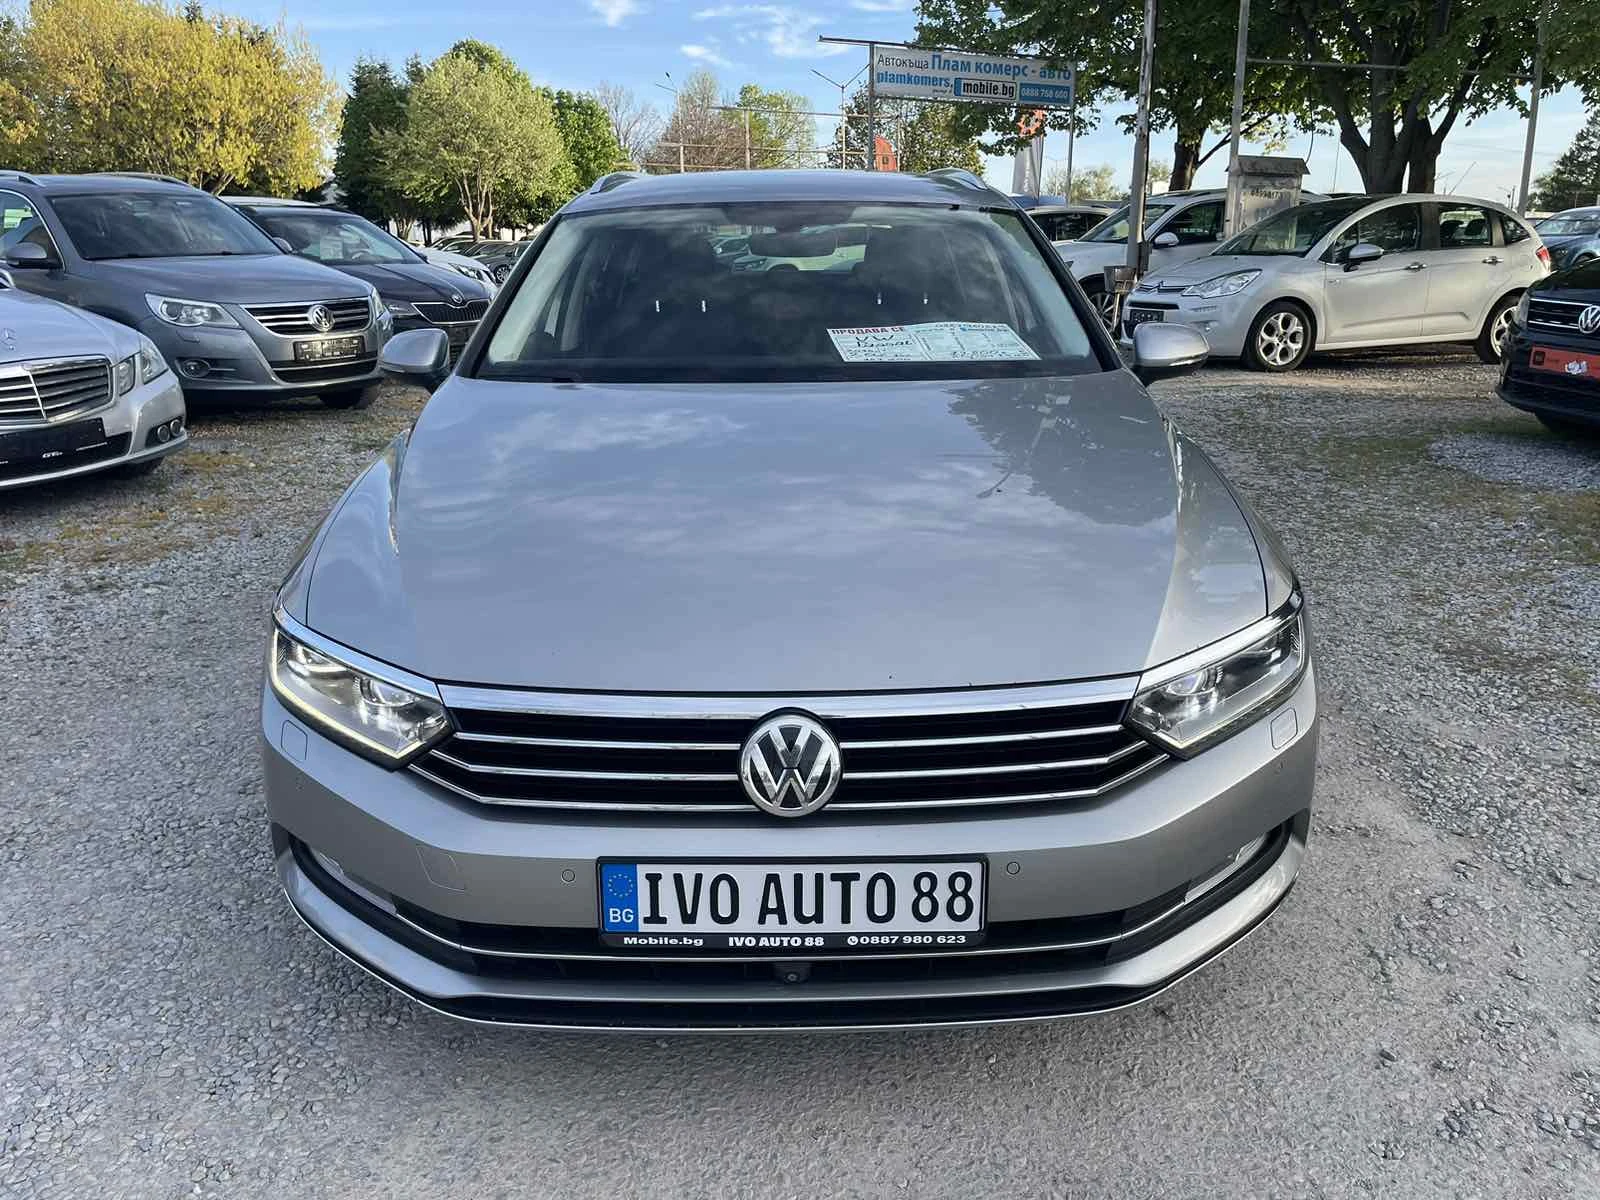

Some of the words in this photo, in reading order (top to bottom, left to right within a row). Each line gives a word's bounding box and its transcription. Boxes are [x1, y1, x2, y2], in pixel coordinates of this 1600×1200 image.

[877, 54, 929, 69] Автокъща
[931, 54, 971, 73] Плам
[975, 61, 1028, 80] комерс
[962, 81, 1015, 98] mobile.bg
[744, 717, 838, 814] VW
[643, 873, 740, 925] IVO
[757, 872, 896, 925] AUTO
[911, 871, 974, 923] 88
[609, 908, 634, 923] BG
[623, 937, 704, 946] Mobile.bg
[728, 936, 757, 947] IVO
[758, 936, 802, 947] AUTO
[804, 937, 825, 947] 88
[859, 935, 900, 945] 0887
[902, 935, 933, 944] 980
[936, 934, 967, 944] 623
